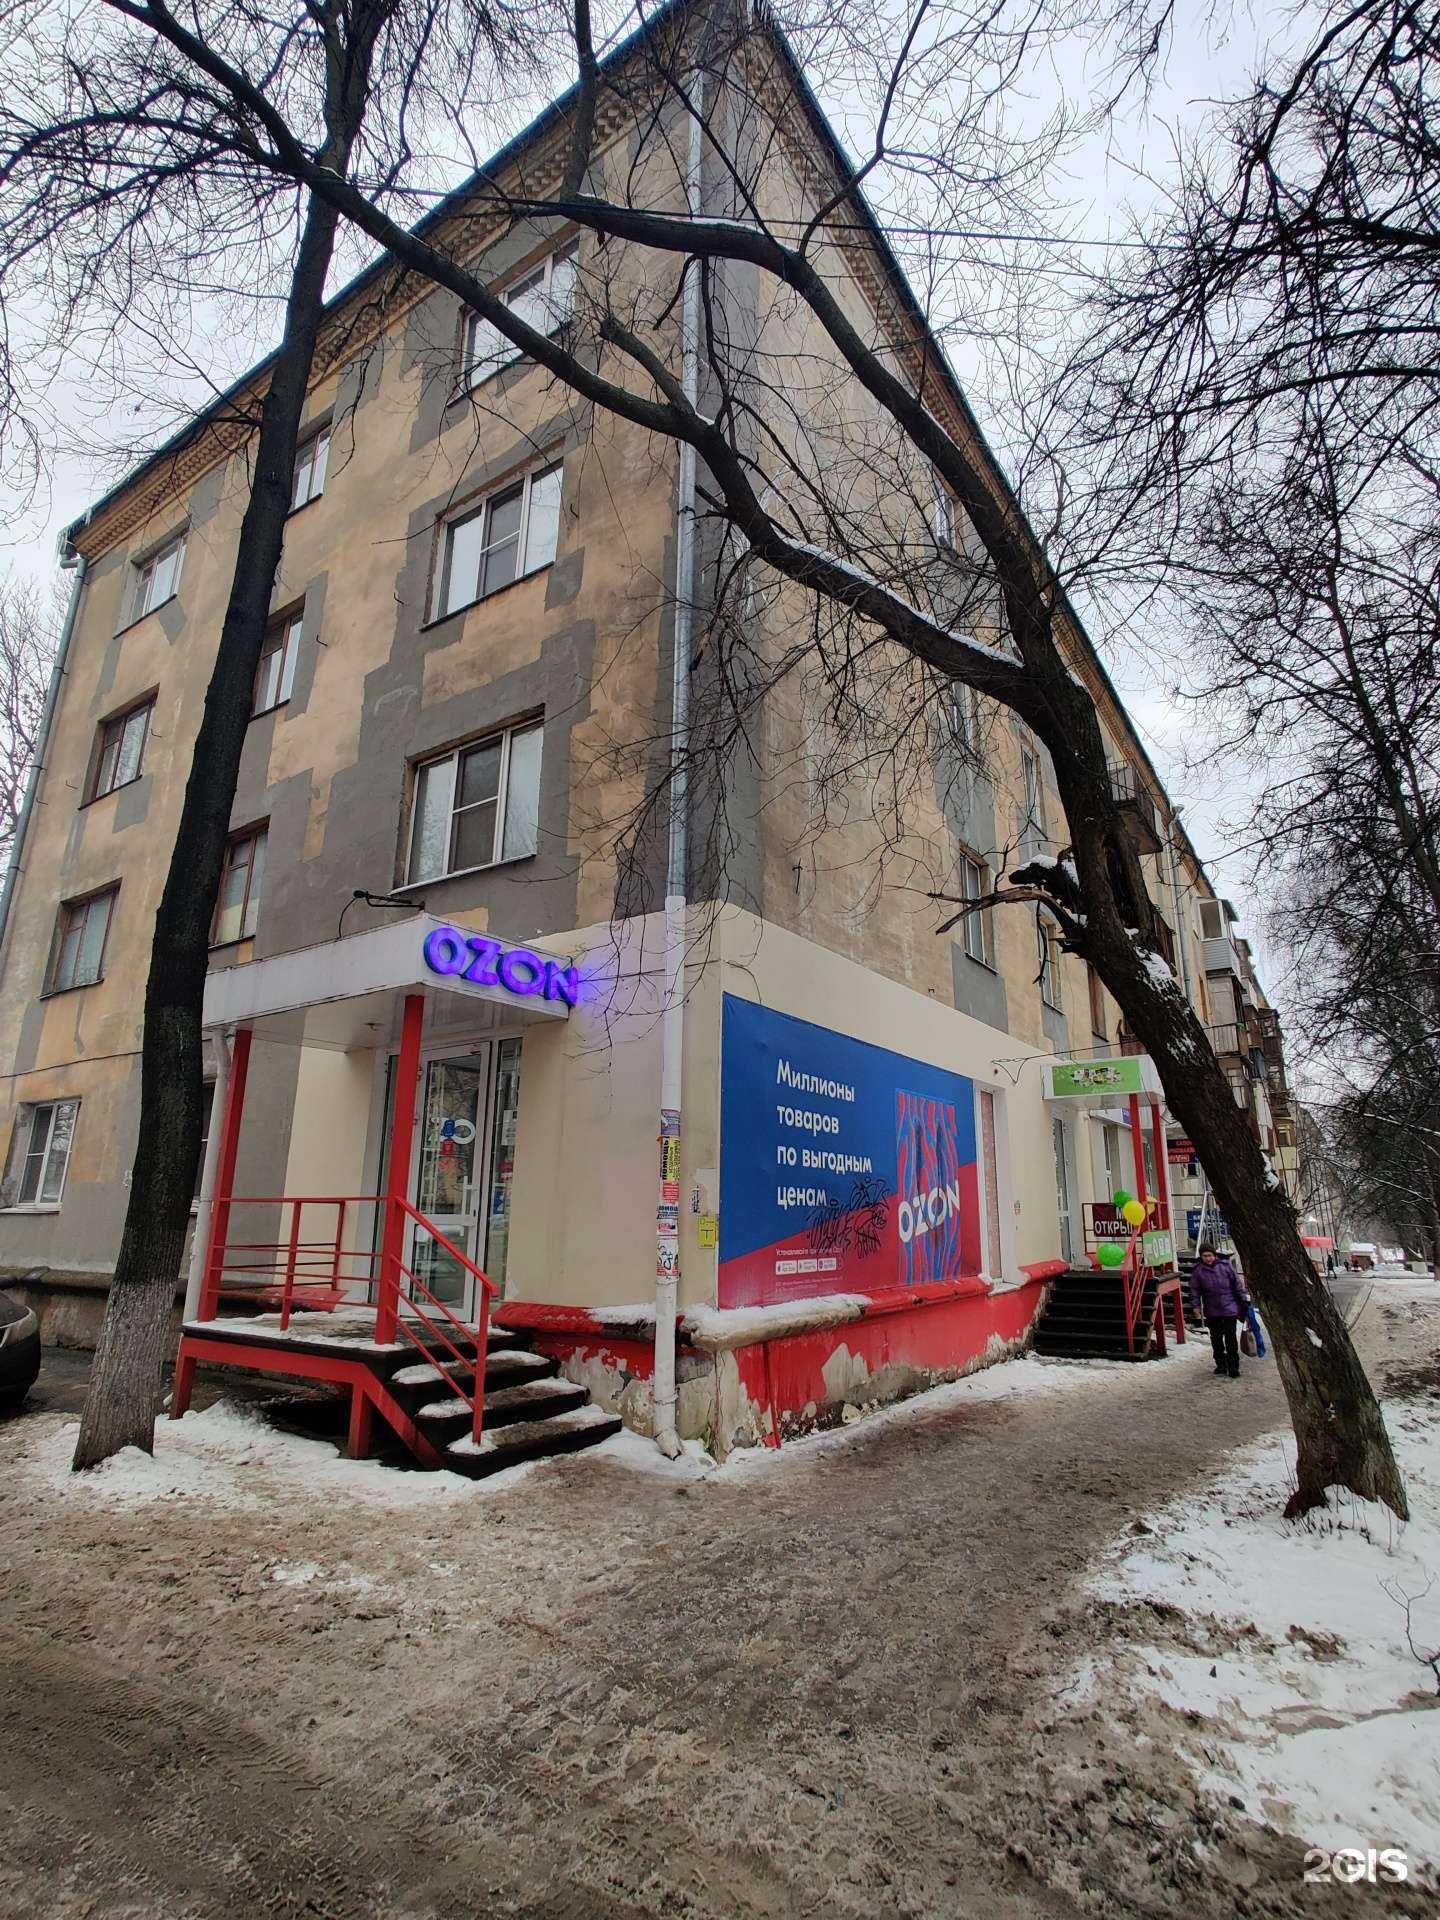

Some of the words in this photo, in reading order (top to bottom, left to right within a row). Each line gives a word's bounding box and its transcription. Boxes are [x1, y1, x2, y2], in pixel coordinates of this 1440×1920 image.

[423, 927, 579, 1006] OZON
[776, 1058, 855, 1102] Миллионы
[776, 1105, 840, 1136] товаров
[777, 1145, 797, 1166] по
[802, 1149, 872, 1175] выгодным
[777, 1186, 828, 1210] ценам
[898, 1179, 960, 1242] OZON
